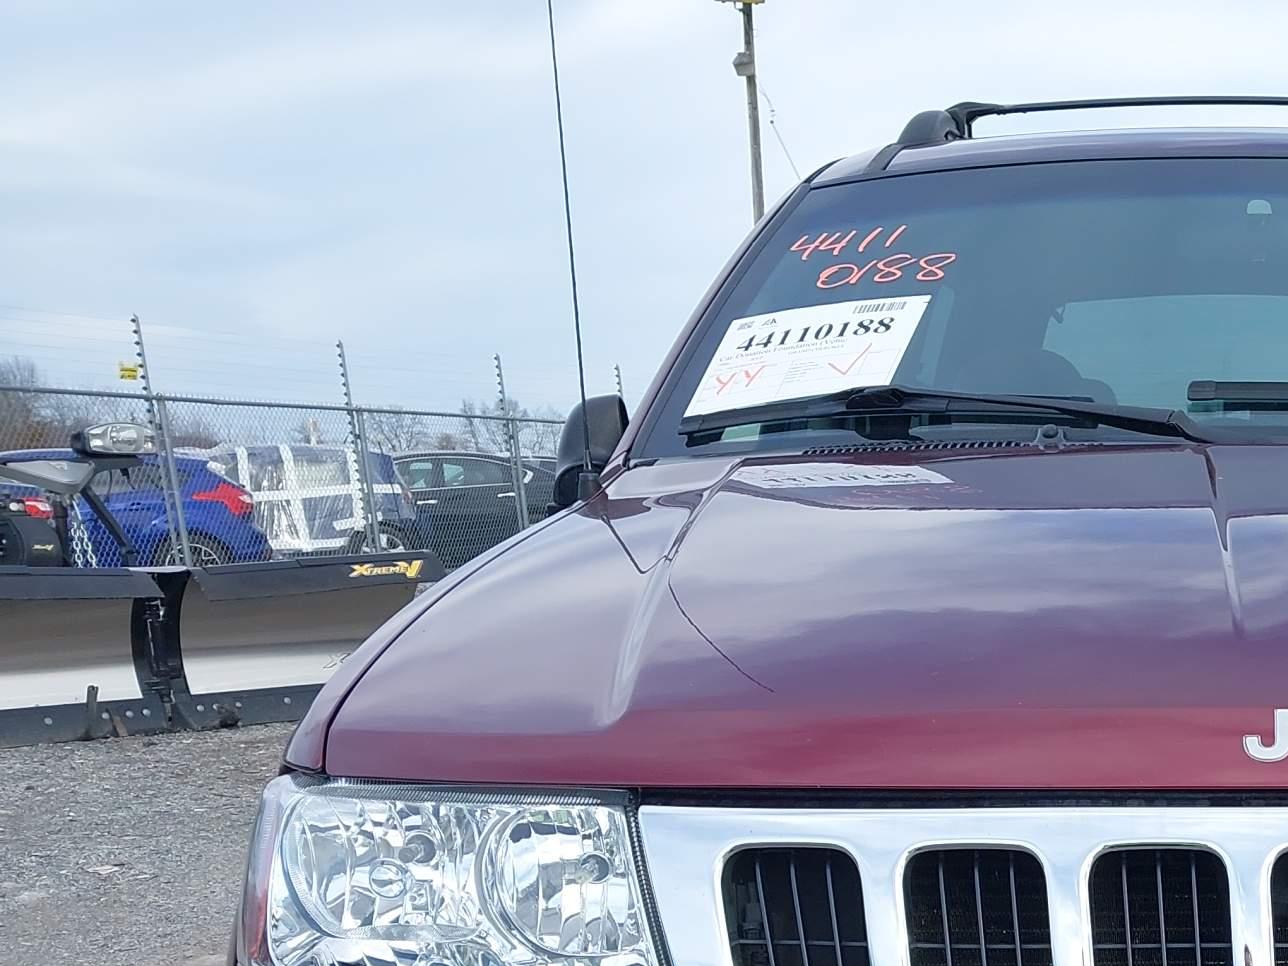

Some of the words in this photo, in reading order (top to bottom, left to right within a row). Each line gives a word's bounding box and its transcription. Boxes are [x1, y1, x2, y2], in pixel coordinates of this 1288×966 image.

[790, 225, 907, 260] 4411
[816, 254, 956, 289] 0188
[736, 317, 896, 352] 44110188
